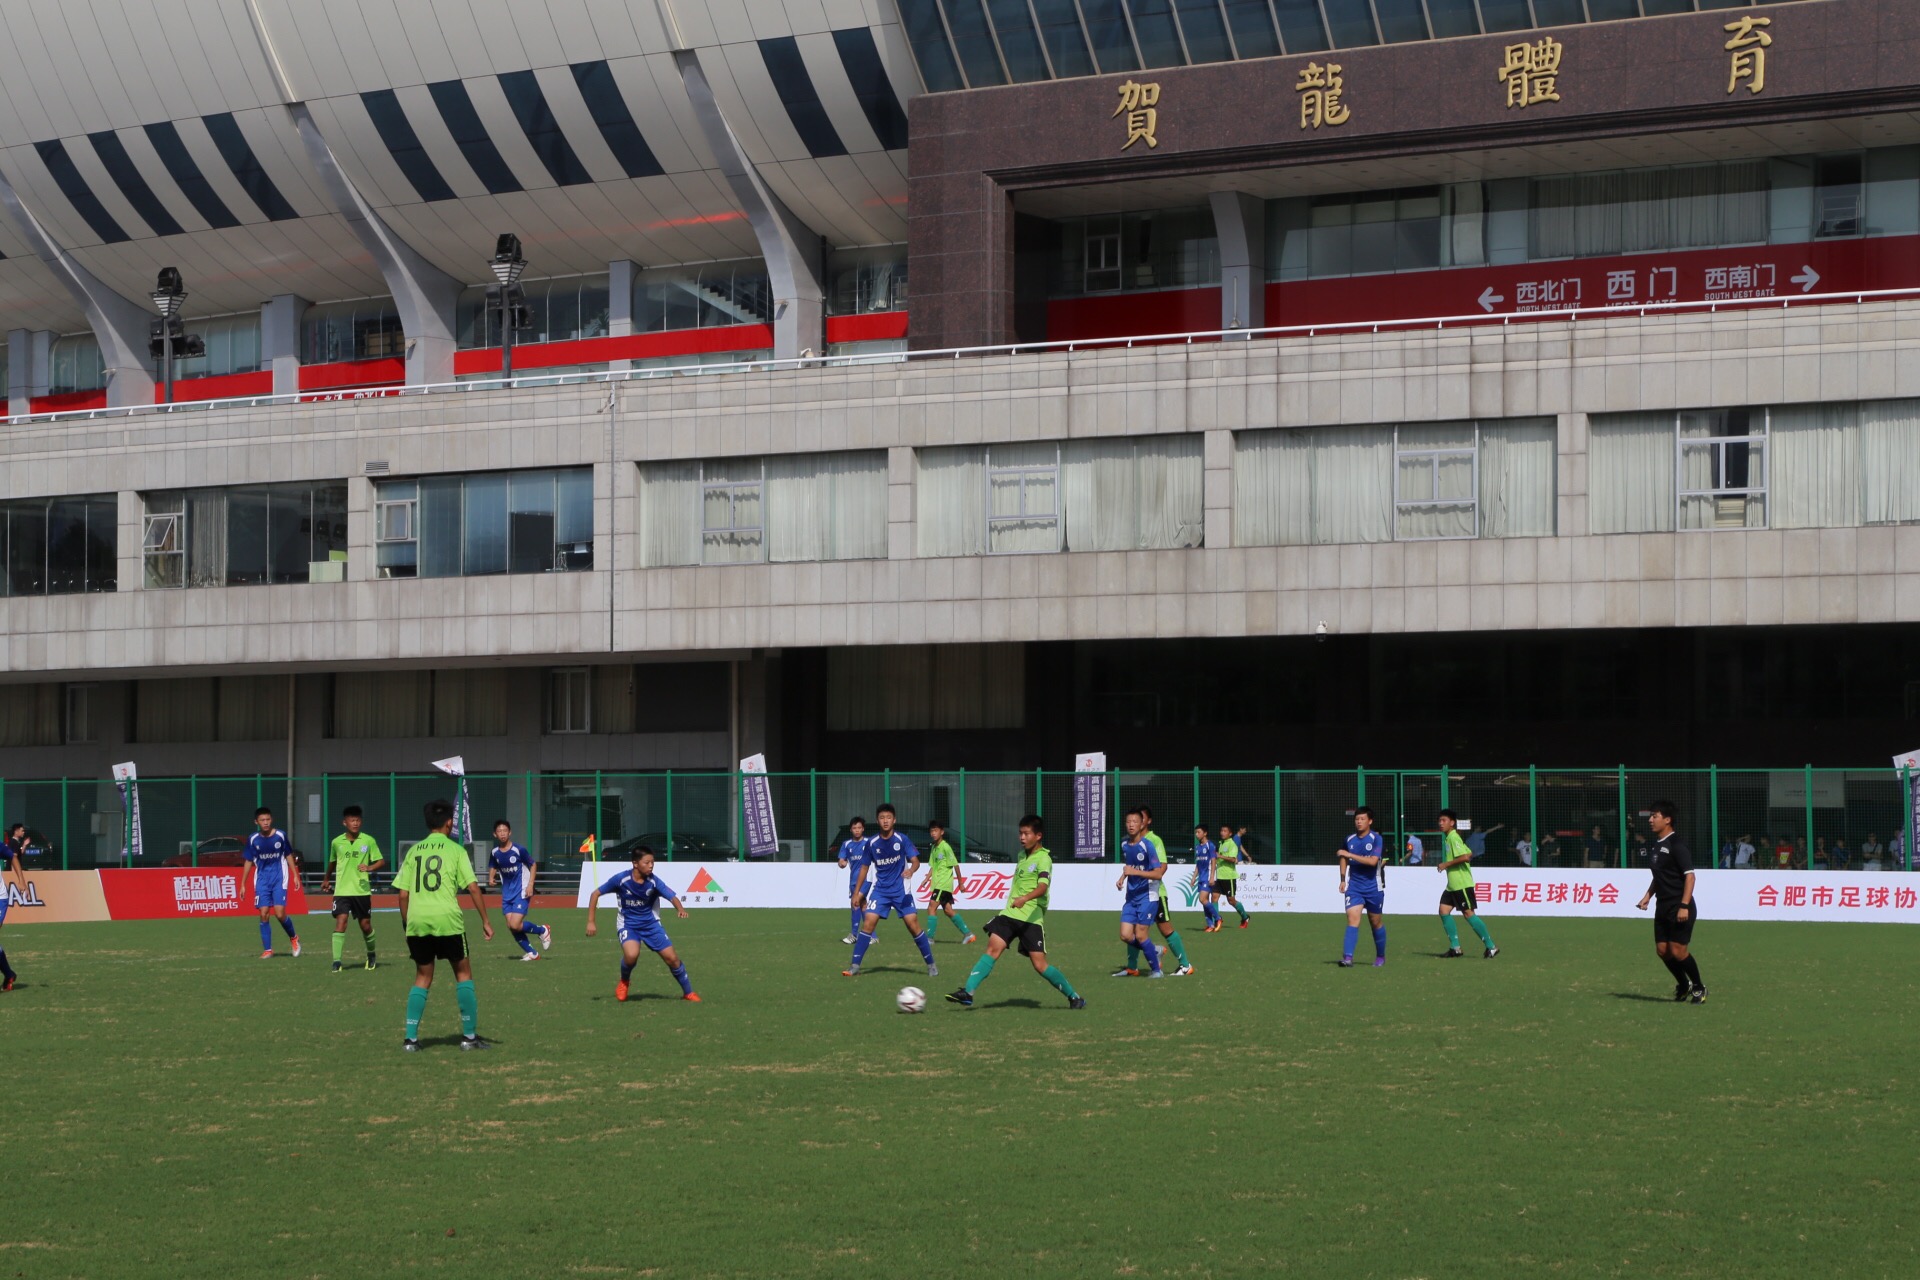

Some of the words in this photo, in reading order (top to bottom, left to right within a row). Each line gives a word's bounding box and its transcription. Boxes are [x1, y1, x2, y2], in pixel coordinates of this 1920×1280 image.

[1606, 267, 1677, 299] 西门
[1705, 264, 1775, 290] 西南门
[1516, 278, 1581, 304] 西北门
[1704, 291, 1730, 301] SOUTH
[1732, 290, 1753, 299] WEST
[1755, 288, 1775, 297] GATE
[1516, 305, 1540, 313] NORTH
[1542, 303, 1561, 312] WEST
[1563, 302, 1582, 311] GATE
[414, 855, 443, 893] 18
[173, 875, 237, 900] 酷盈体育
[1260, 884, 1275, 892] CITY
[1276, 885, 1297, 893] HOTEL
[1474, 882, 1619, 904] 昌市足球协会
[1757, 884, 1918, 909] 合肥市足球协
[177, 900, 239, 914] kuyingsports
